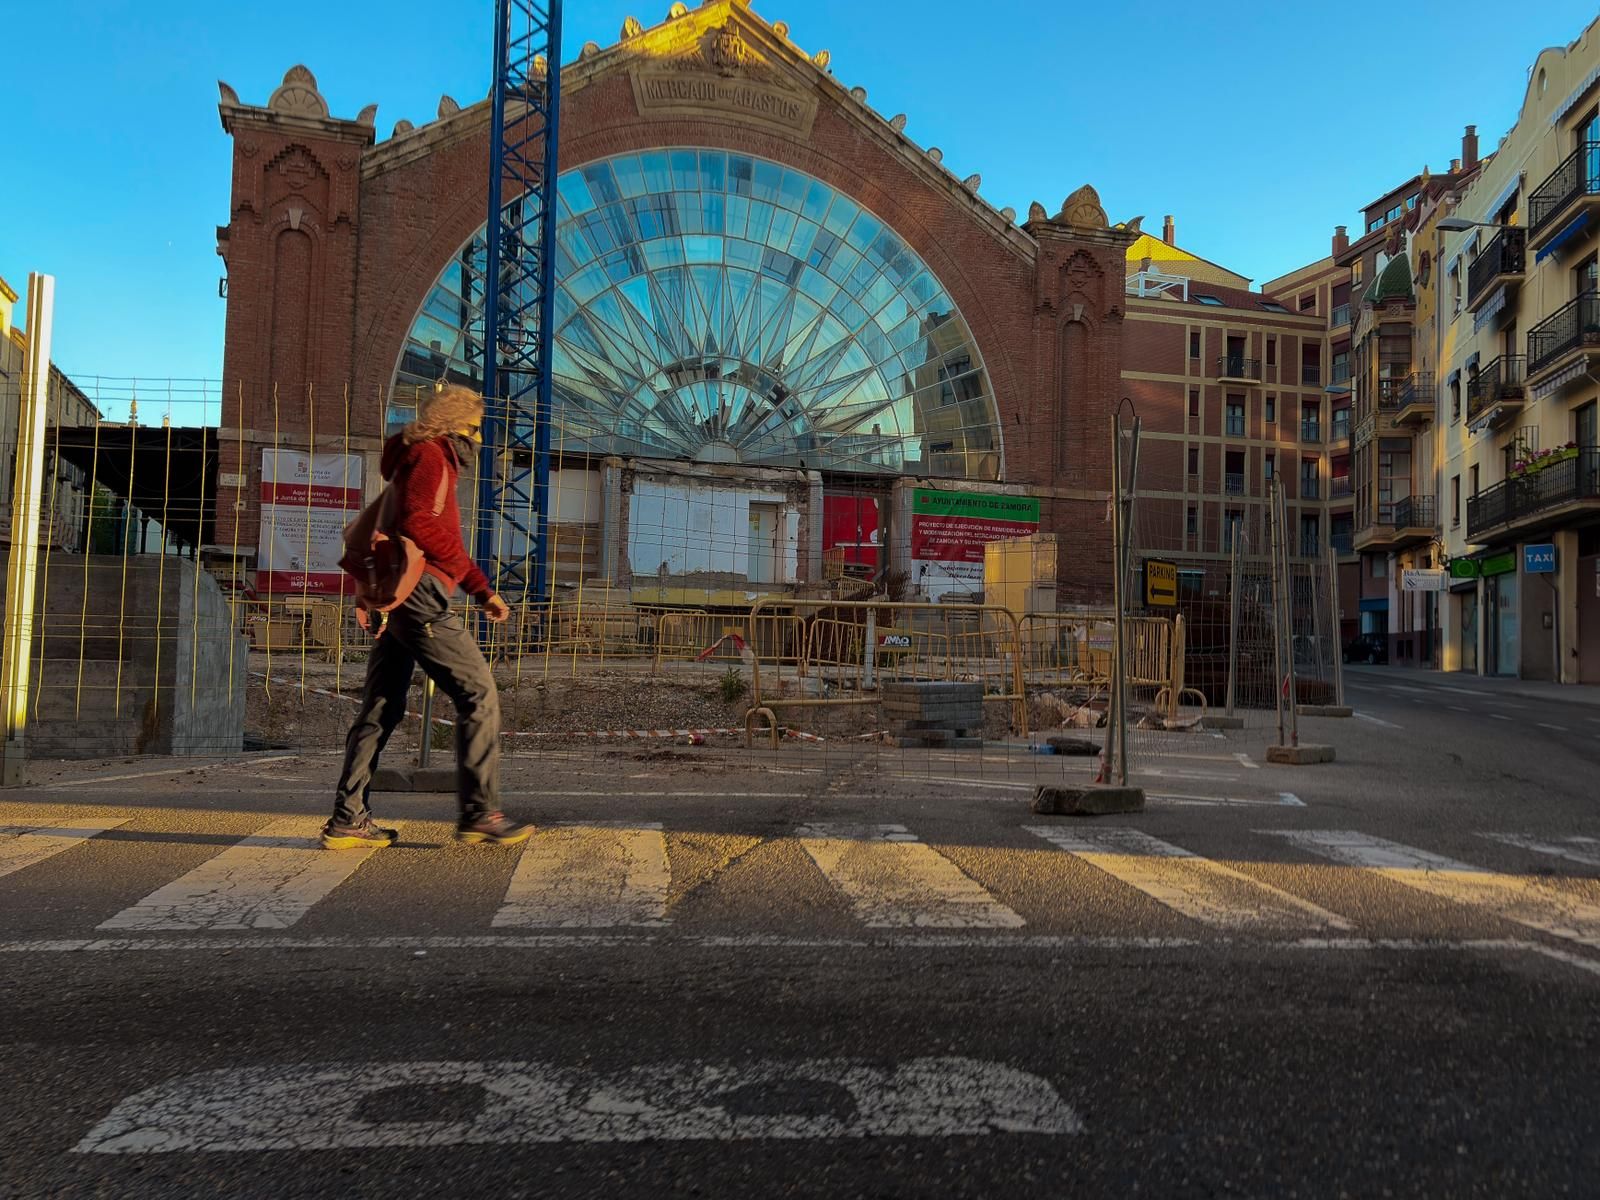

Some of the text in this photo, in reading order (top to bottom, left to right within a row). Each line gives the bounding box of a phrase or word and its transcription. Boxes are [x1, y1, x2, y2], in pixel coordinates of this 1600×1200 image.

[645, 79, 718, 101] MERCADO
[732, 86, 801, 120] ABASTOS
[932, 497, 1033, 512] AYUNTAMIENTO DE ZAMORA
[918, 521, 946, 529] PROYECTO
[954, 522, 984, 531] EJECUCIÓN
[992, 526, 1032, 535] REMODELACIÓN
[923, 529, 964, 537] MODERNIZACIÓN
[1526, 552, 1553, 563] TAXI
[1149, 564, 1174, 580] PARKING
